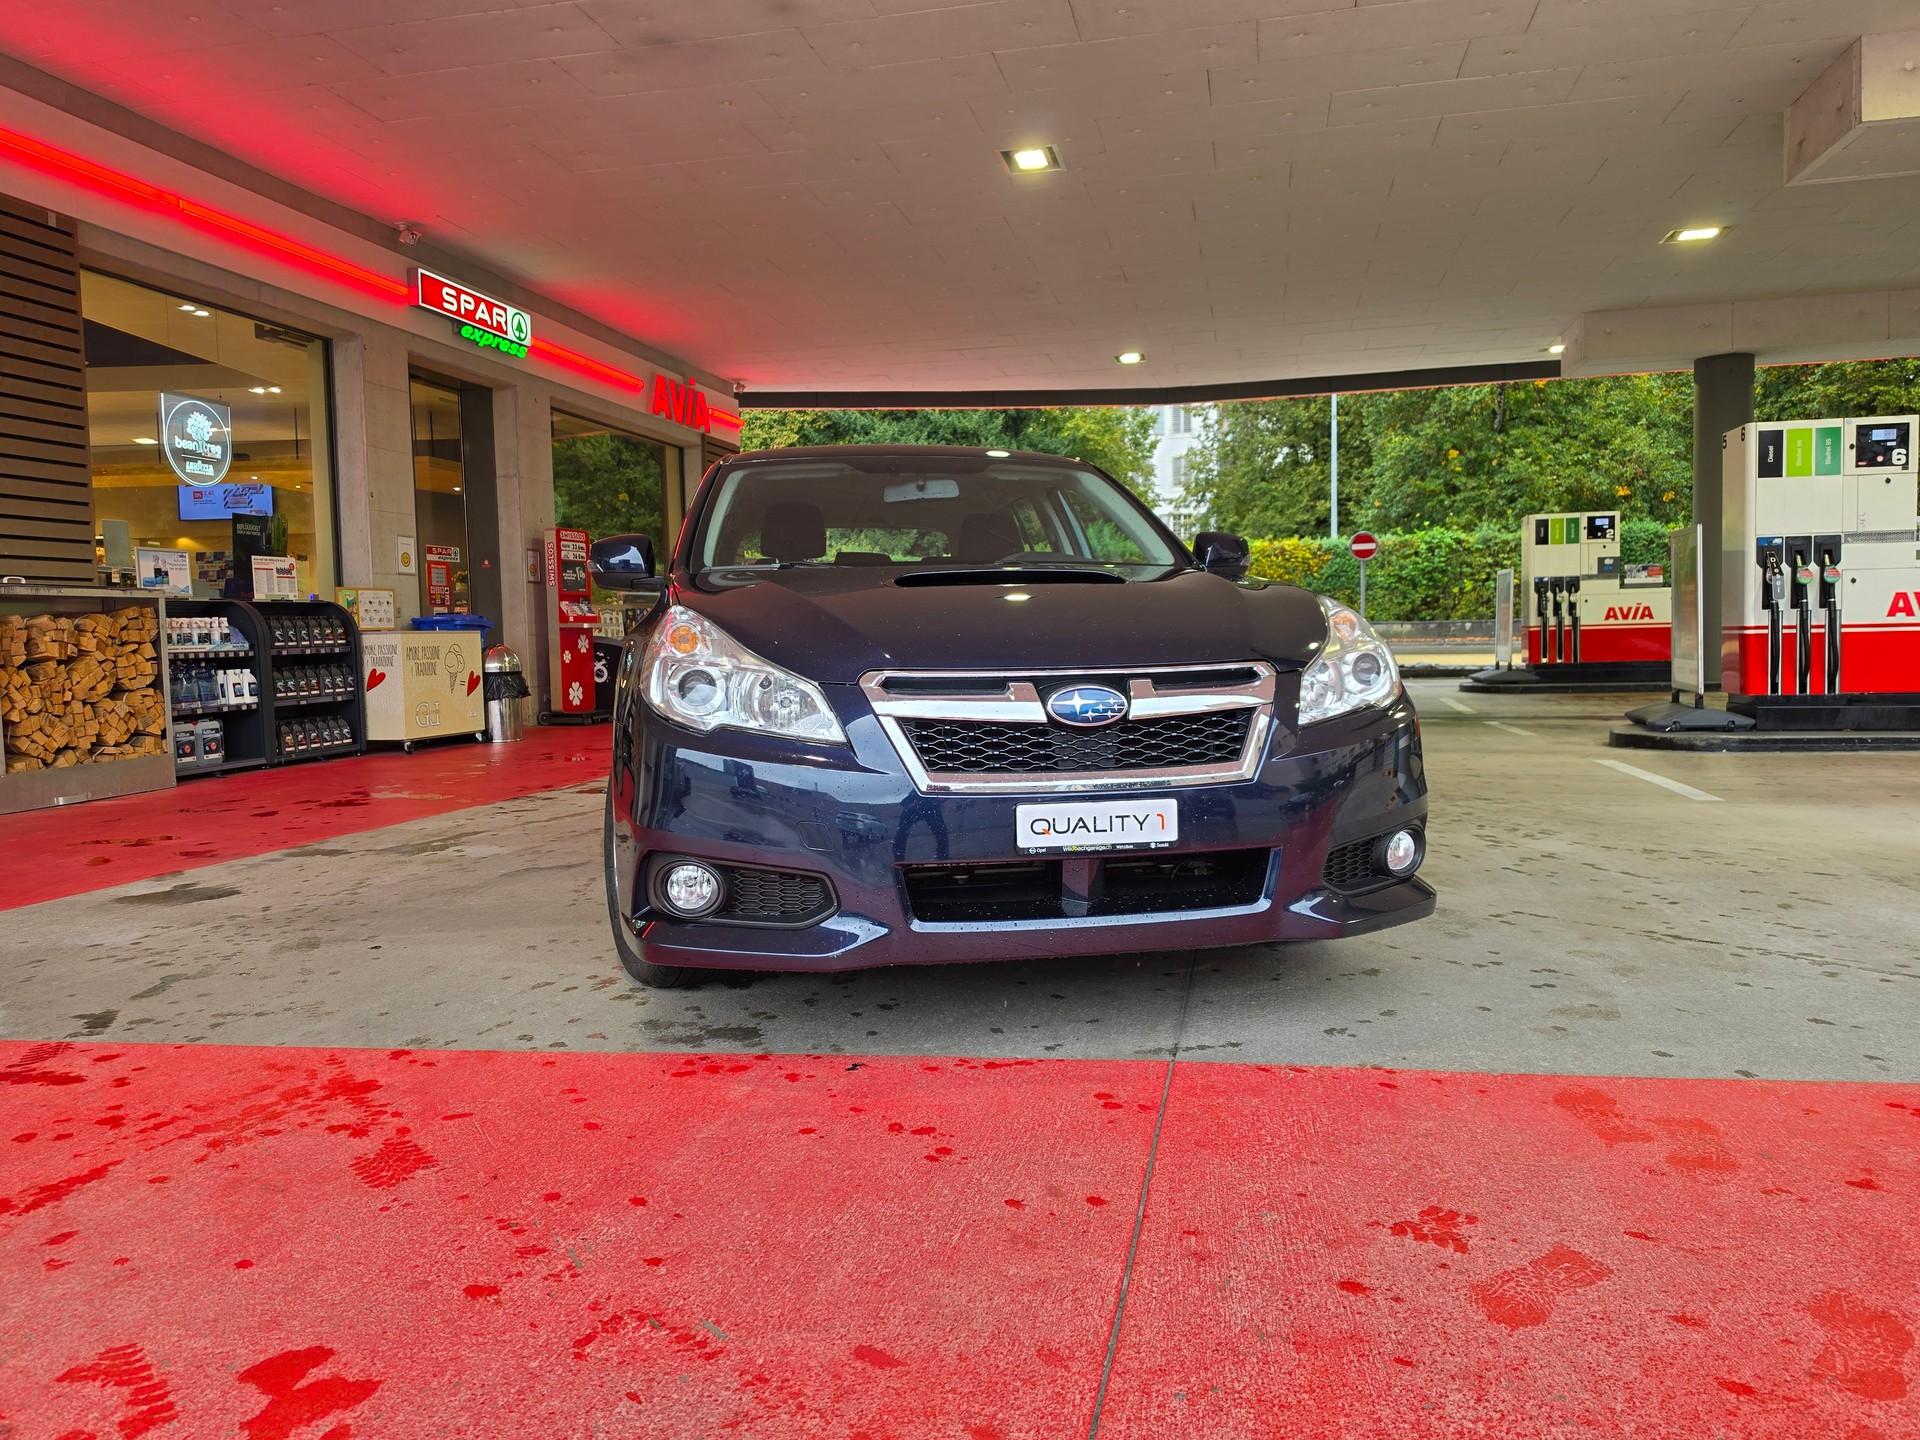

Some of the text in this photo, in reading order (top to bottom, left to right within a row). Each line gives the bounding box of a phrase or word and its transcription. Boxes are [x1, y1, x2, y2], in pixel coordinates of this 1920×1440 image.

[441, 286, 507, 332] SPAR
[460, 323, 528, 359] express
[174, 435, 222, 454] bean tree
[1722, 427, 1746, 449] 5 6
[1891, 448, 1907, 465] 6
[560, 530, 586, 541] SWISSLOS
[1606, 529, 1614, 538] 2
[1770, 556, 1781, 593] Diesel
[377, 644, 399, 655] PASSIONE
[406, 646, 441, 661] AMORE PASSIONE
[415, 661, 438, 676] TRADIZIONE
[1030, 814, 1165, 836] QUALITY 1
